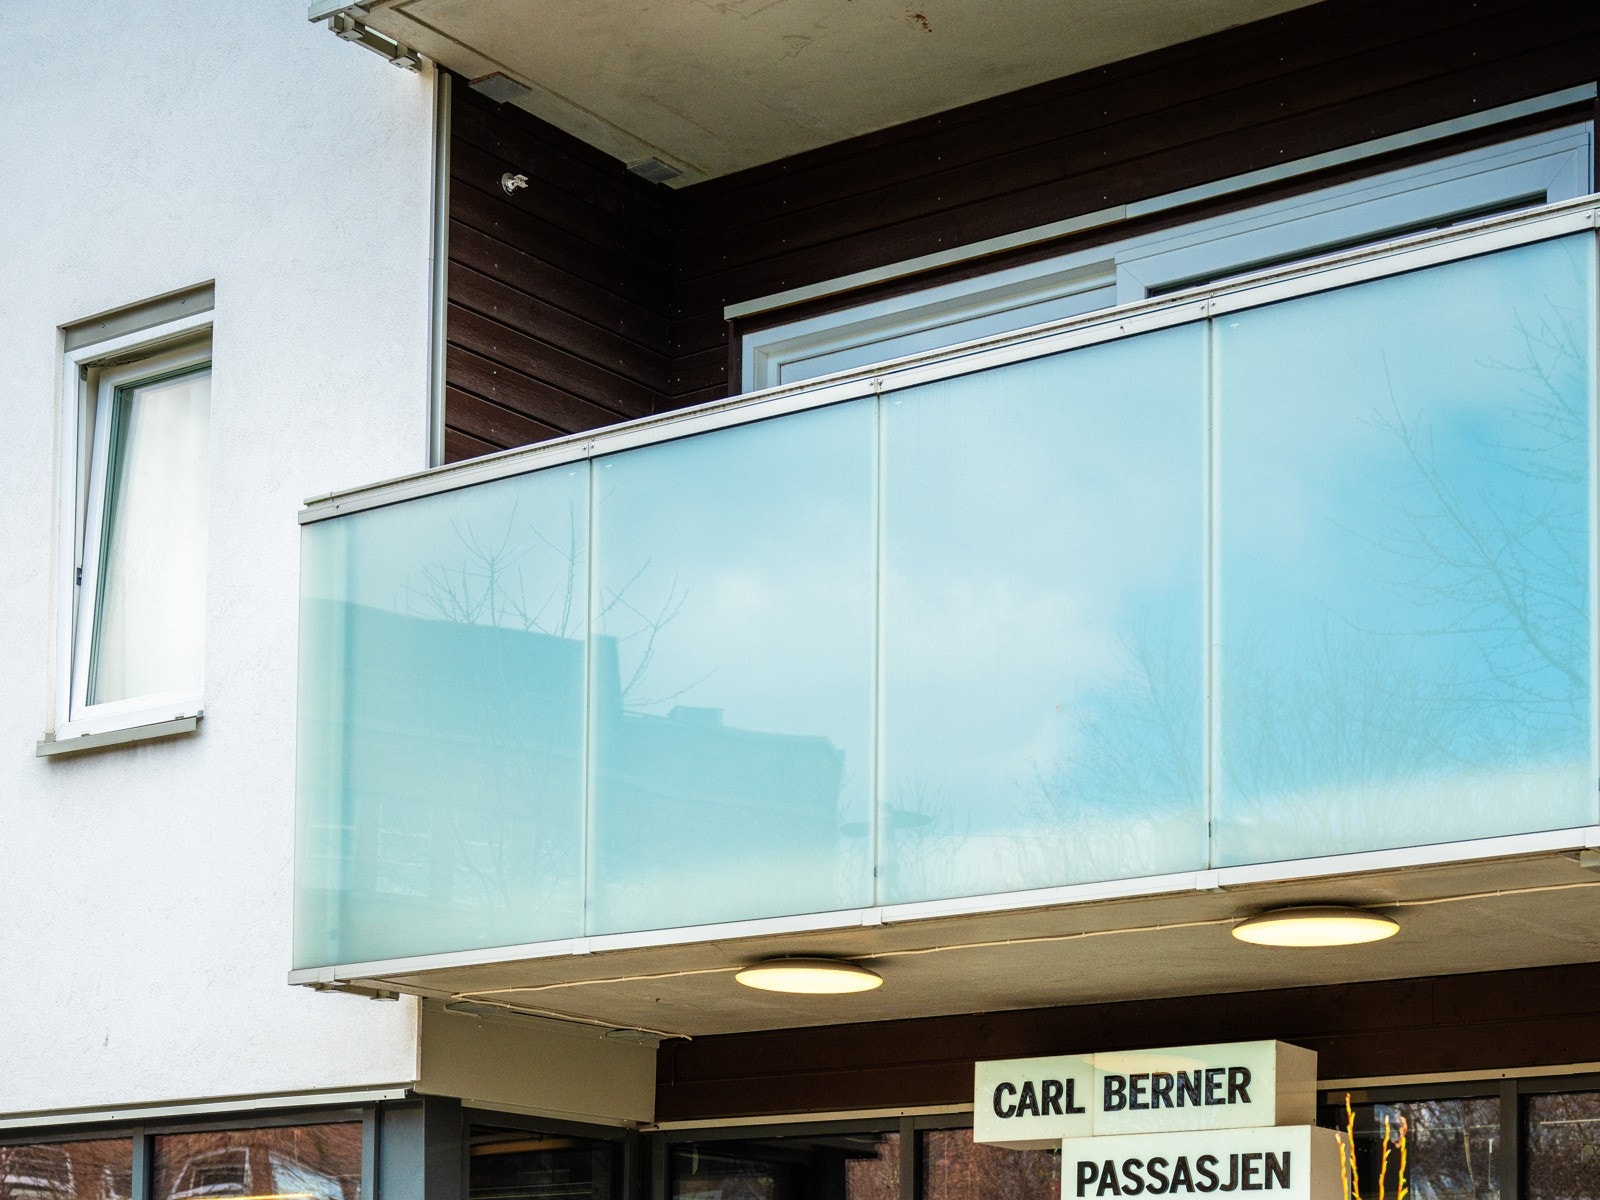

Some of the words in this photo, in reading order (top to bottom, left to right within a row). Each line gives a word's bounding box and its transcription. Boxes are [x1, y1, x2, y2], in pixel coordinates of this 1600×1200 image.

[993, 1078, 1086, 1119] CARL
[1103, 1066, 1252, 1112] BERNER
[1076, 1151, 1291, 1198] PASSASJEN
